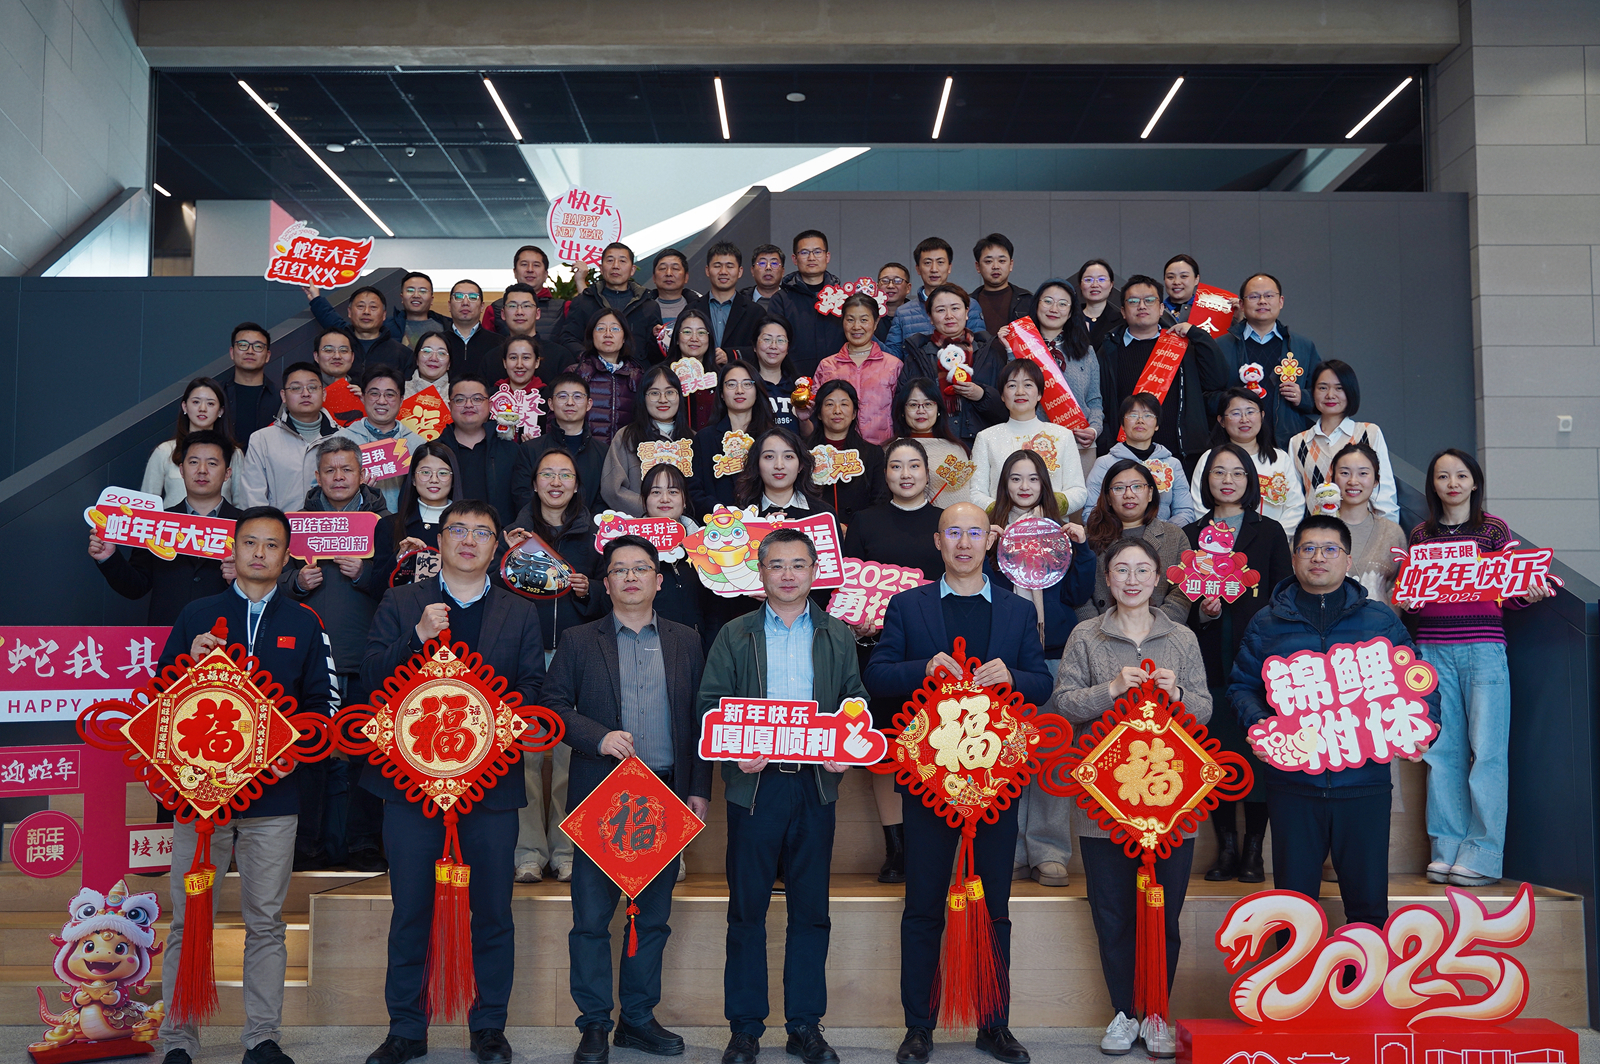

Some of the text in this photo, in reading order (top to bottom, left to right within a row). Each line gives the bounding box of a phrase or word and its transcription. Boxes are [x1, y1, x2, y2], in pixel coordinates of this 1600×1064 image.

[567, 188, 613, 217] 快乐
[562, 212, 601, 228] HAPPY
[555, 226, 604, 241] NEW YEAR
[292, 241, 360, 267] 蛇年大吉
[558, 239, 603, 268] 出发
[272, 259, 340, 284] 红红火火
[1018, 338, 1037, 352] luck
[1155, 347, 1180, 361] spring
[1151, 360, 1174, 371] returns
[1147, 374, 1165, 384] the
[1045, 392, 1071, 410] become
[362, 448, 387, 466] 自我
[364, 461, 397, 479] 高峰
[105, 493, 157, 510] 2025
[104, 513, 228, 555] 蛇年行大运
[290, 517, 349, 533] 团结奋进
[628, 522, 678, 536] 蛇年好运
[307, 536, 369, 553] 守正创新
[642, 535, 673, 547] 你行
[1413, 545, 1475, 561] 欢喜无限
[843, 561, 921, 593] 2025
[1399, 552, 1549, 599] 蛇年快乐
[526, 586, 541, 594] 2025
[1185, 579, 1240, 597] 迎新春
[1439, 592, 1482, 603] 2025
[438, 648, 450, 662] 吉
[1266, 641, 1399, 717] 锦鲤
[8, 698, 82, 714] HAPPY
[723, 703, 810, 725] 新年快乐
[1139, 700, 1156, 720] 吉
[176, 697, 246, 764] 福
[366, 724, 378, 736] 如
[409, 694, 478, 764] 福
[512, 720, 524, 732] 意
[929, 694, 1003, 773] 福
[1297, 697, 1433, 771] 附体
[710, 726, 837, 758] 嘎嘎顺利
[1, 757, 77, 784] 迎蛇年
[1079, 766, 1094, 782] 如
[1113, 737, 1184, 808] 福
[1203, 766, 1218, 782] 意
[439, 795, 452, 807] 祥
[609, 792, 657, 852] 福
[26, 826, 65, 845] 新年
[1139, 831, 1160, 852] 祥
[132, 836, 174, 858] 接福
[189, 875, 206, 891] 福
[454, 870, 468, 883] 福
[1147, 891, 1162, 903] 福
[1216, 886, 1531, 1027] 2025
